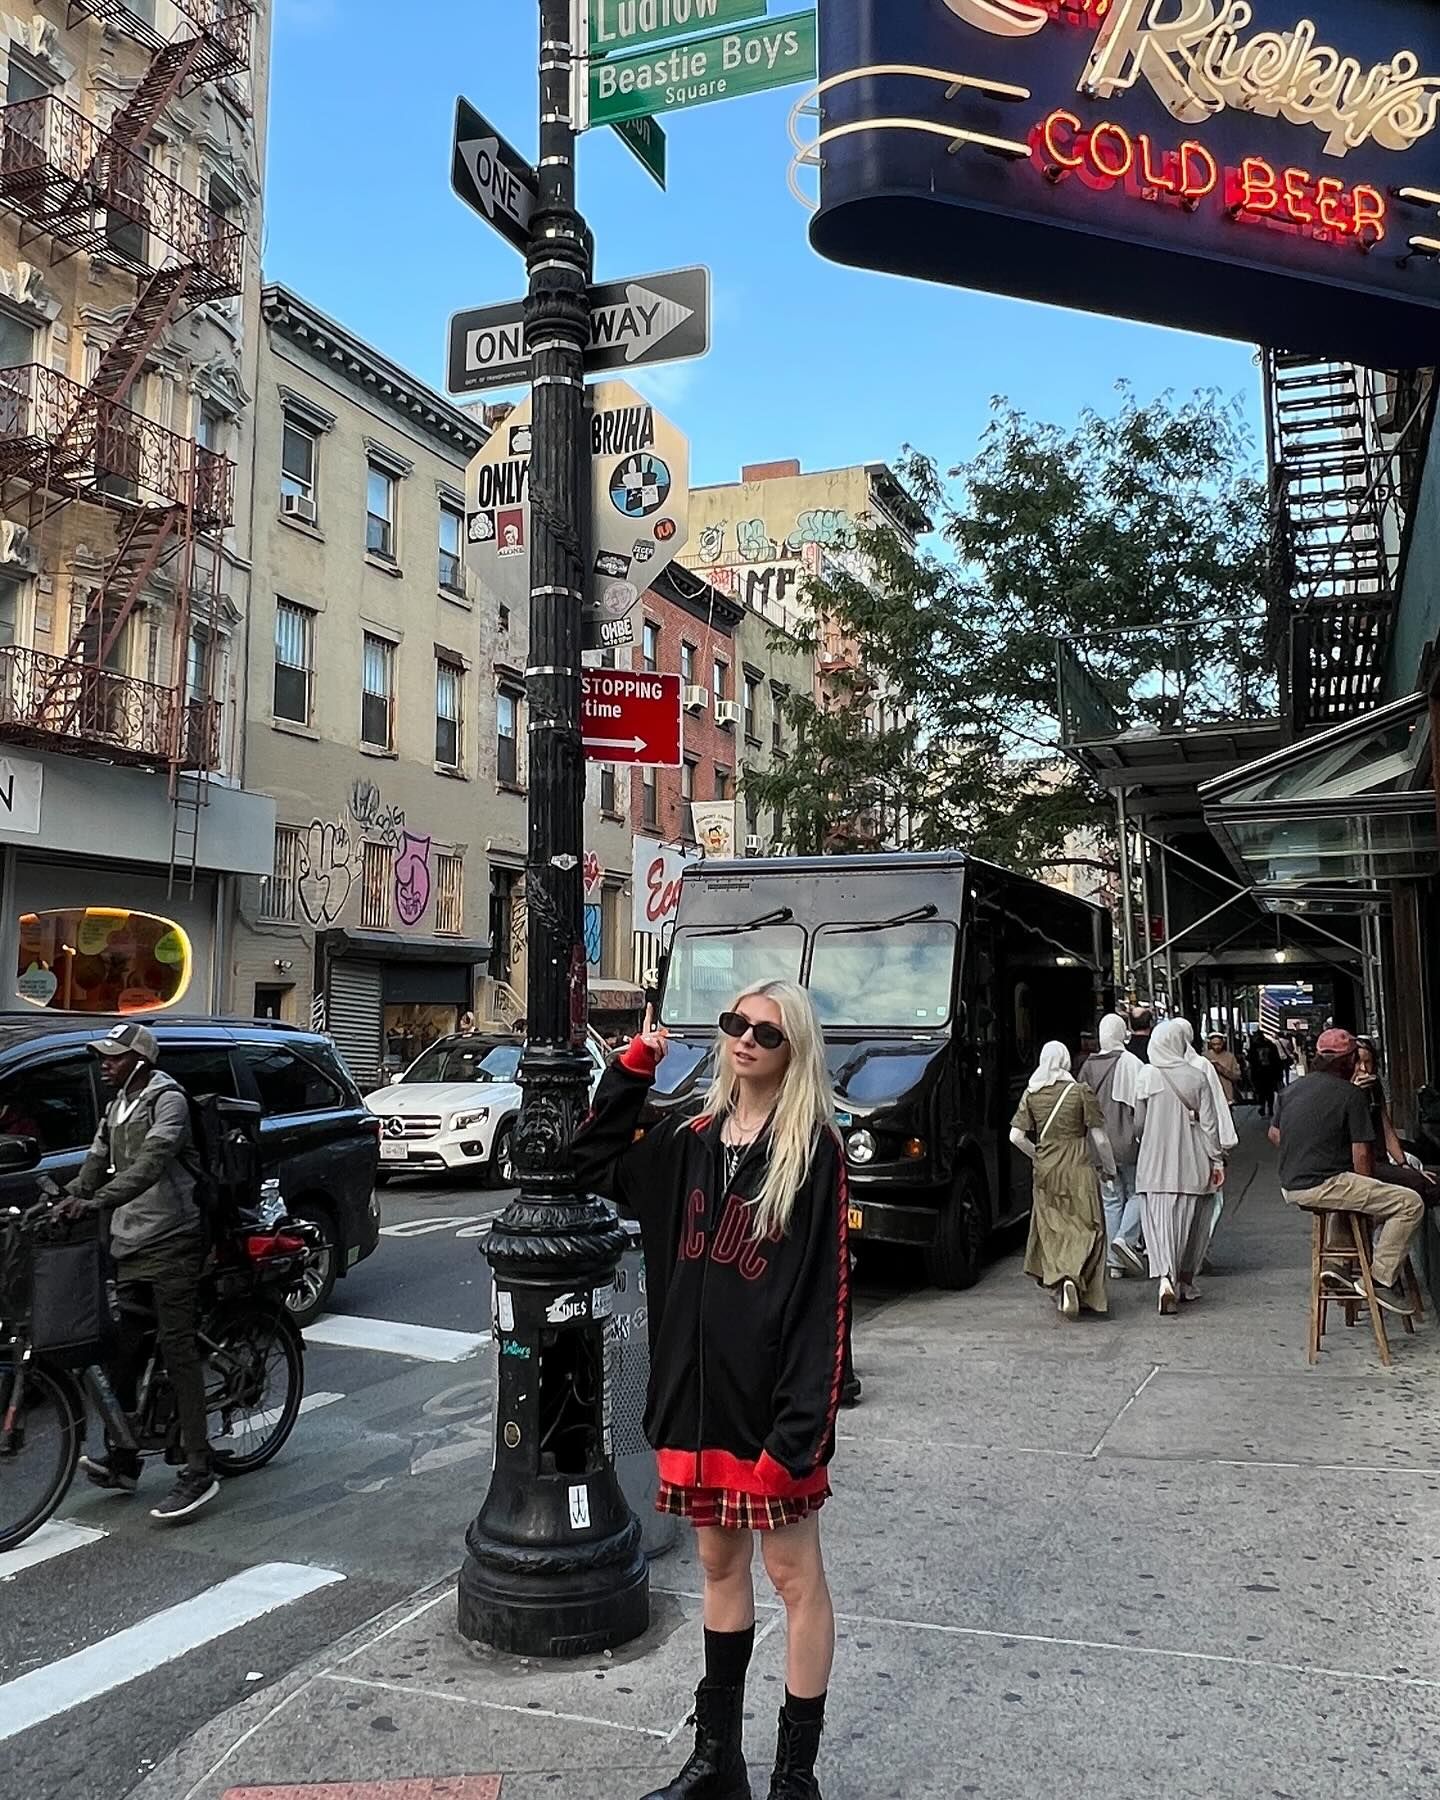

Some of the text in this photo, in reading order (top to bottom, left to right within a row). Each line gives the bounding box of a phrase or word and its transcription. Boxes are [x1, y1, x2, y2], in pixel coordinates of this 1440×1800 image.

[597, 0, 718, 42] Ludlow
[599, 30, 799, 99] Beastie Boys
[665, 78, 727, 105] Square
[476, 151, 521, 219] ONE
[1034, 109, 1386, 242] COLD BEER
[475, 302, 661, 364] ON WAY
[592, 405, 655, 455] BRUHA
[479, 460, 528, 508] ONLY
[581, 698, 622, 718] time
[582, 677, 663, 700] STOPPING
